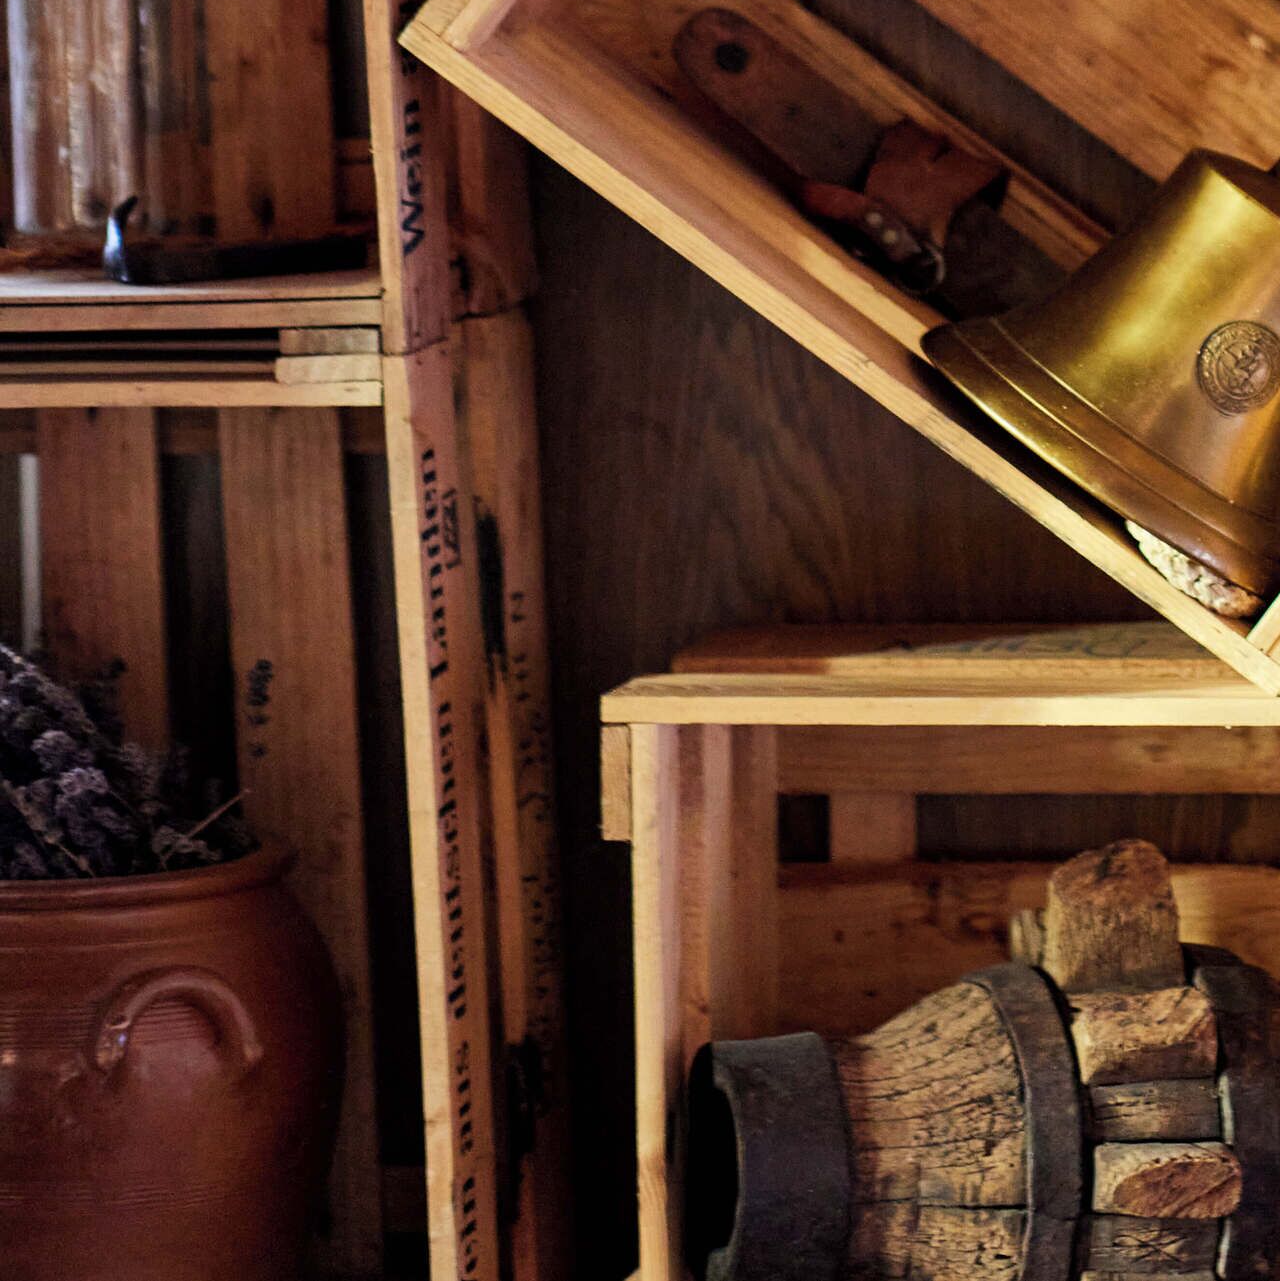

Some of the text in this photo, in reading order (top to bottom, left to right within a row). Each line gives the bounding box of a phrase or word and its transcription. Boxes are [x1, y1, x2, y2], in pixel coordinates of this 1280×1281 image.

[402, 97, 425, 255] Wein
[420, 446, 450, 682] Landen
[435, 700, 469, 1020] deutschen
[456, 1038, 475, 1156] aus
[460, 1176, 479, 1281] ein
